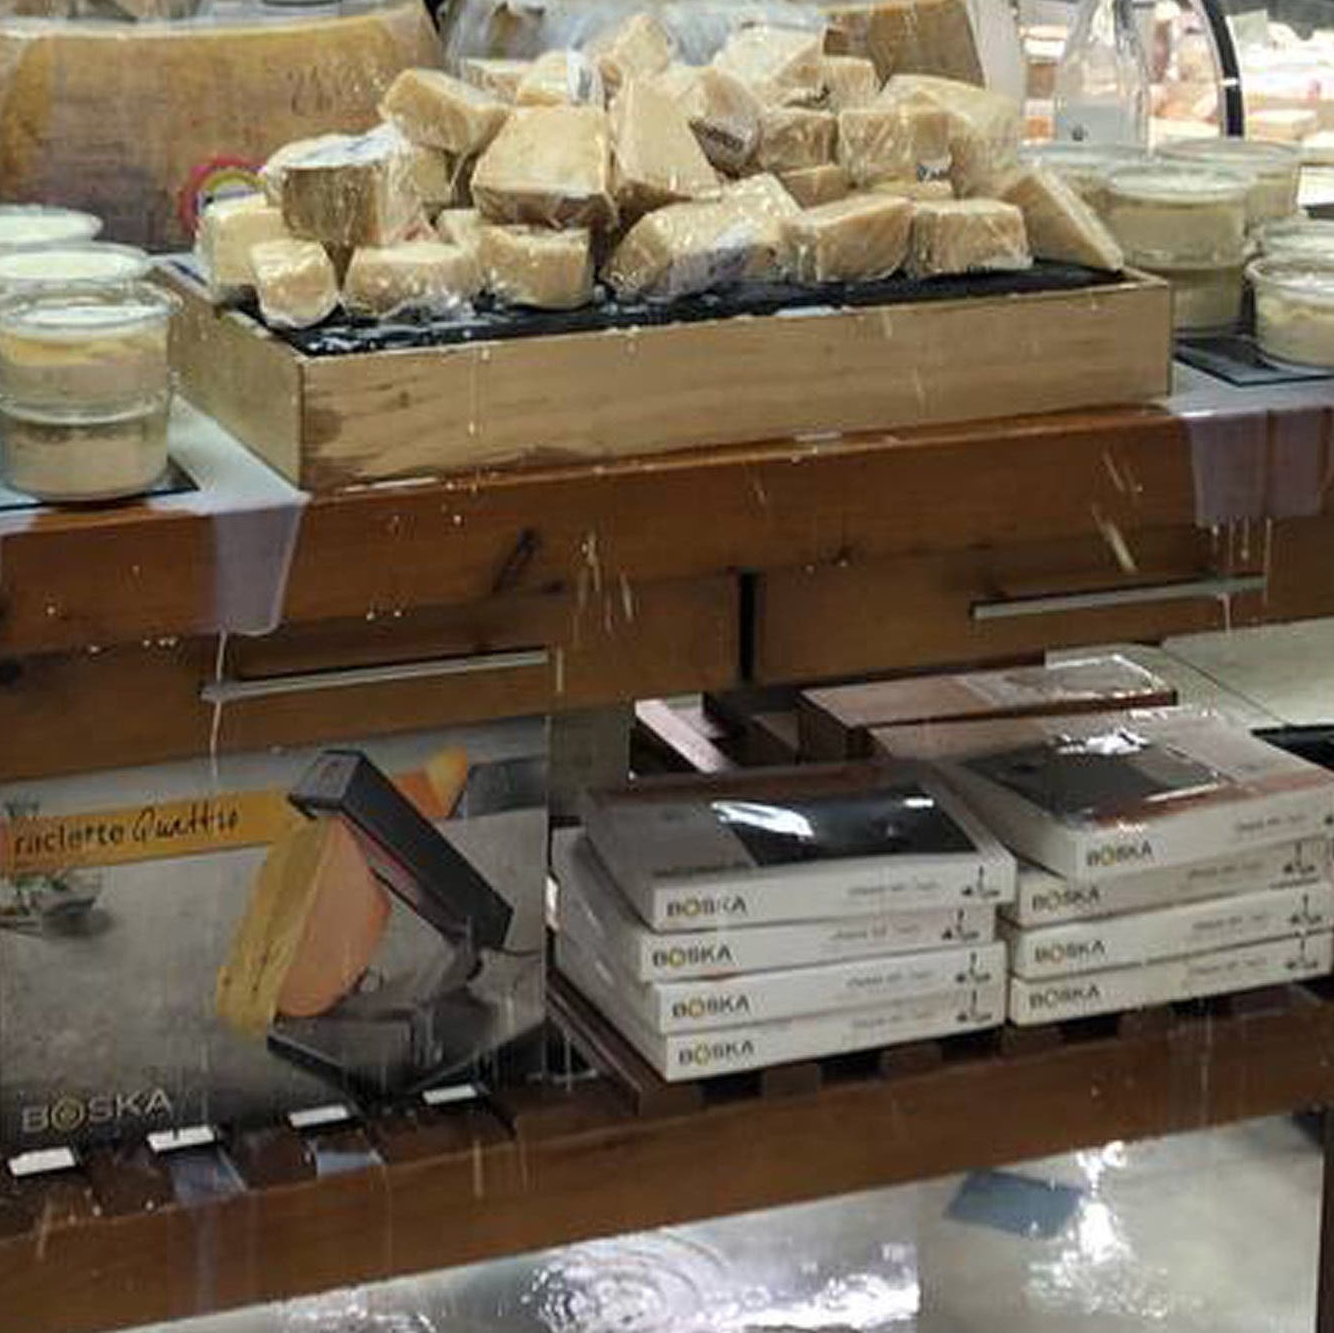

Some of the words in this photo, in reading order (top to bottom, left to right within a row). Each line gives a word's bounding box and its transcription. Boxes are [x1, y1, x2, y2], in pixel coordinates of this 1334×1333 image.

[1086, 840, 1154, 868] BOSKA
[667, 894, 747, 916] BOSKA
[1030, 886, 1101, 912] BOSKA
[652, 946, 734, 968] BOSKA
[1033, 939, 1107, 964] BOSKA
[671, 993, 751, 1019] BOSKA
[1027, 985, 1101, 1011] BOSKA
[678, 1039, 756, 1065] BOSKA
[21, 1088, 173, 1134] BOSKA
